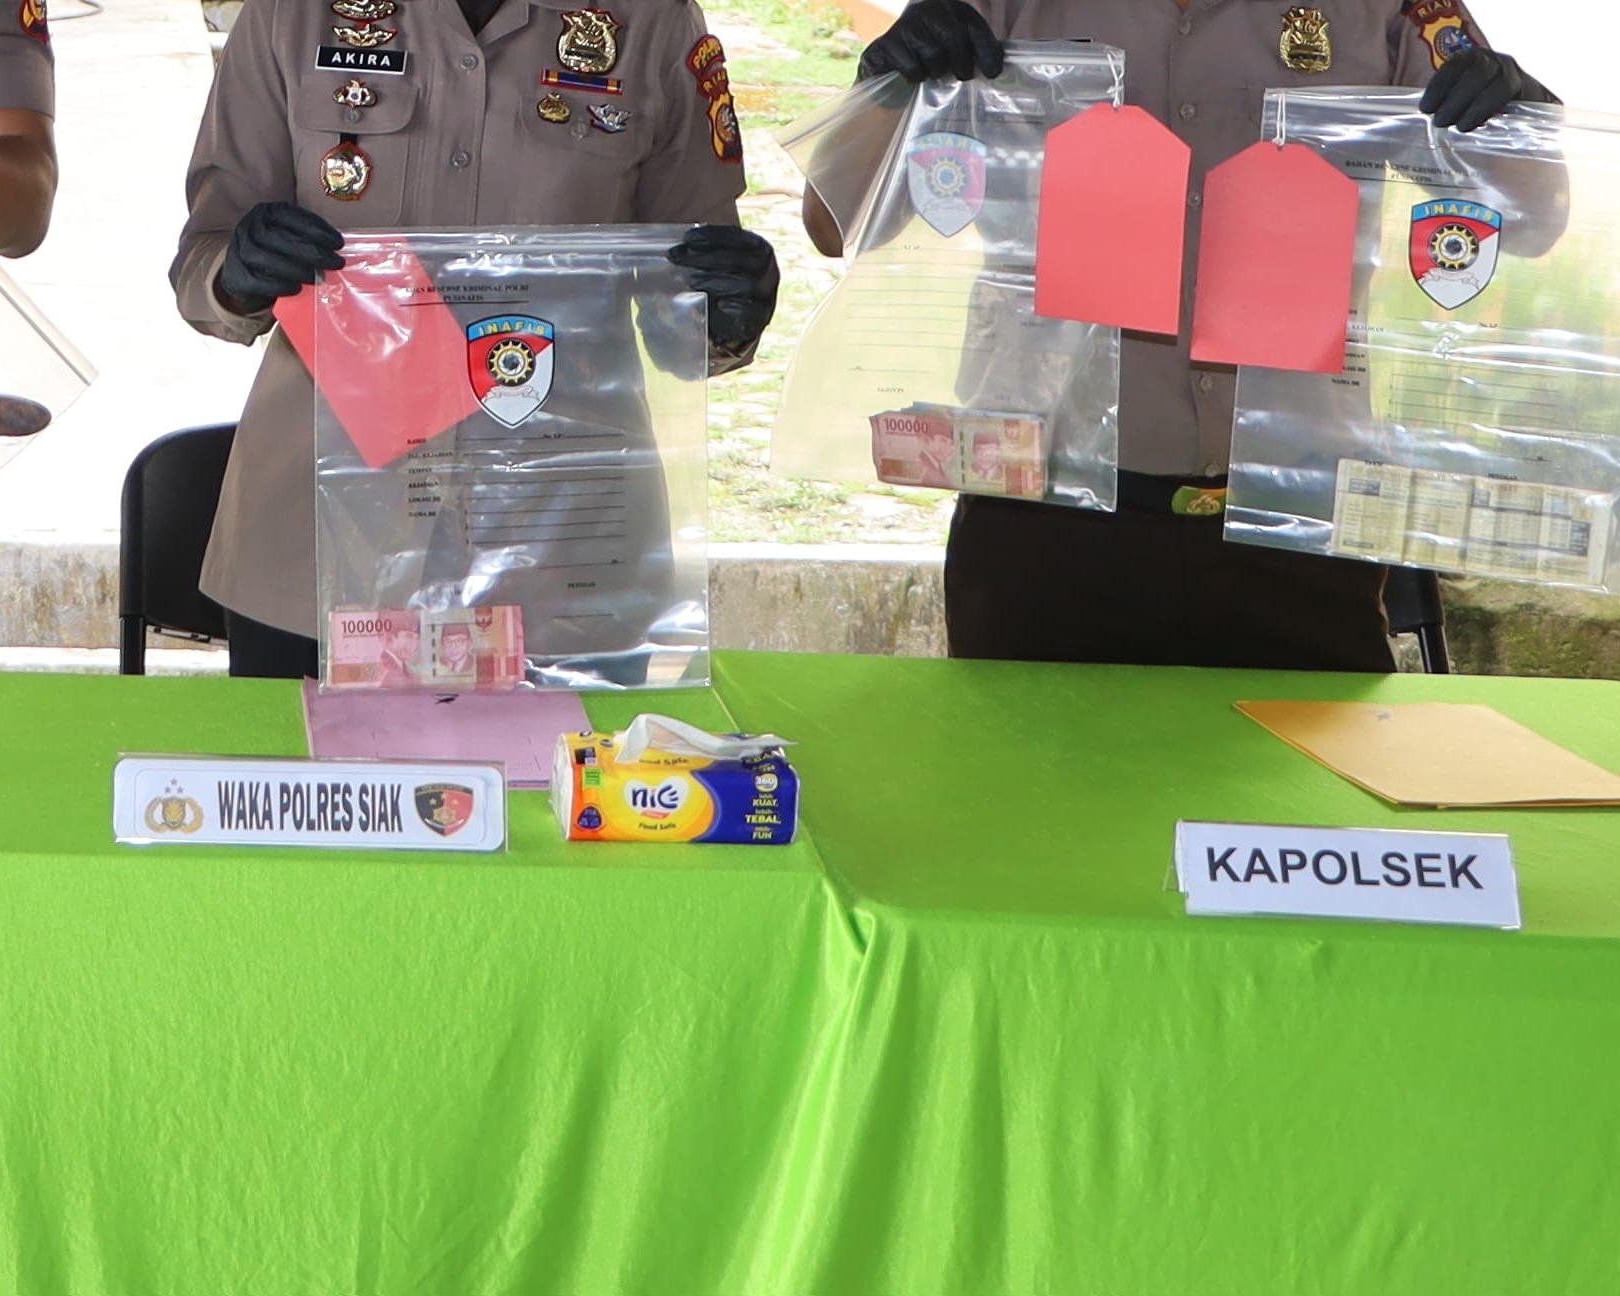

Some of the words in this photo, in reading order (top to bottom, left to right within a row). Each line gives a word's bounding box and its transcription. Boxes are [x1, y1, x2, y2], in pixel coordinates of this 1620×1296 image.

[1417, 0, 1452, 18] RIAU
[331, 50, 392, 67] AKIRA
[1425, 203, 1495, 222] INAFIS
[479, 320, 546, 336] INAFIS
[884, 418, 929, 435] 100000
[341, 619, 393, 634] 100000
[217, 780, 274, 831] WAKA
[279, 782, 354, 832] POLRES
[359, 783, 404, 833] SIAK
[1206, 846, 1484, 890] KAPOLSEK
